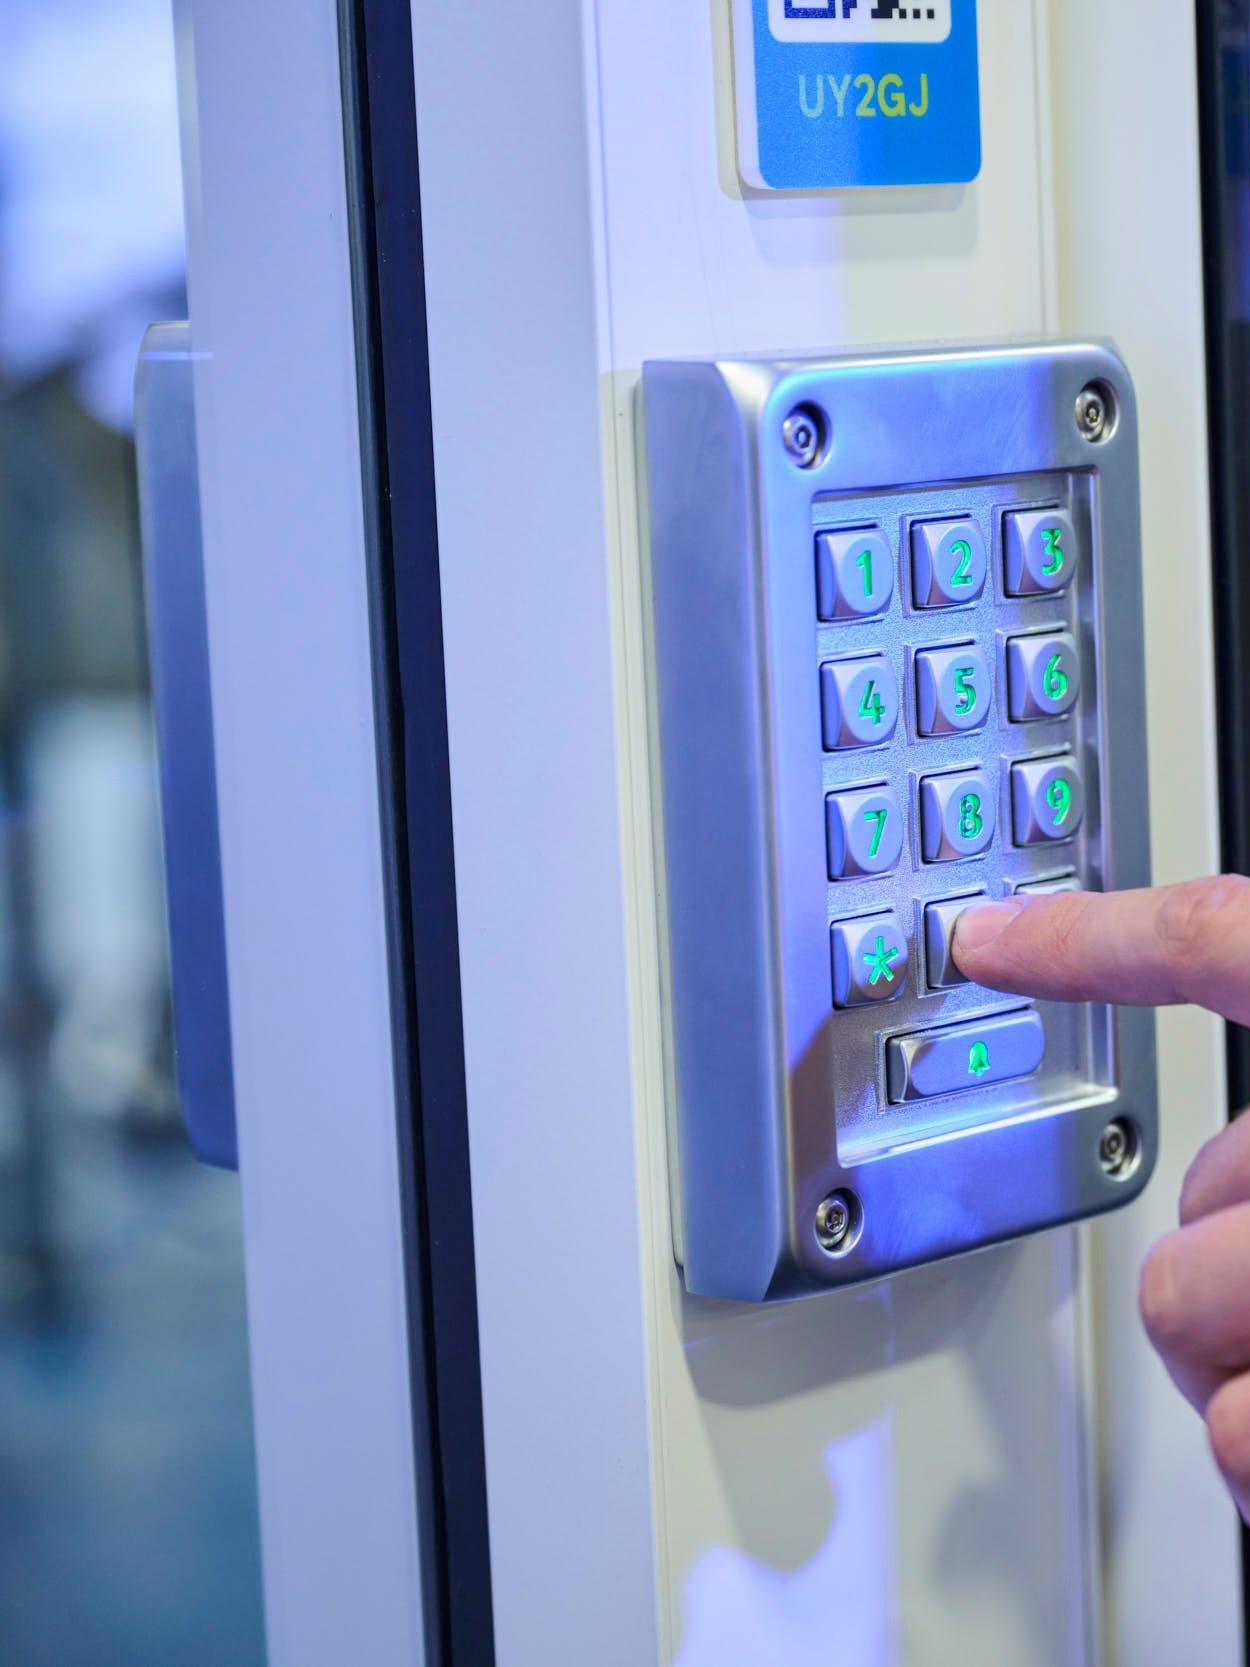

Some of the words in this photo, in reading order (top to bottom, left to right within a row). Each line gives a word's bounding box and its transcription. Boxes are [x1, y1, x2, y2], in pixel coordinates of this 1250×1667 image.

[799, 73, 929, 118] UY2GJ
[855, 549, 873, 598] 1
[950, 539, 974, 588] 2
[1041, 528, 1065, 576] 3
[858, 680, 886, 727] 4
[954, 667, 977, 716] 5
[1043, 653, 1069, 700] 6
[863, 808, 888, 857] 7
[959, 793, 983, 840] 8
[1046, 778, 1073, 825] 9
